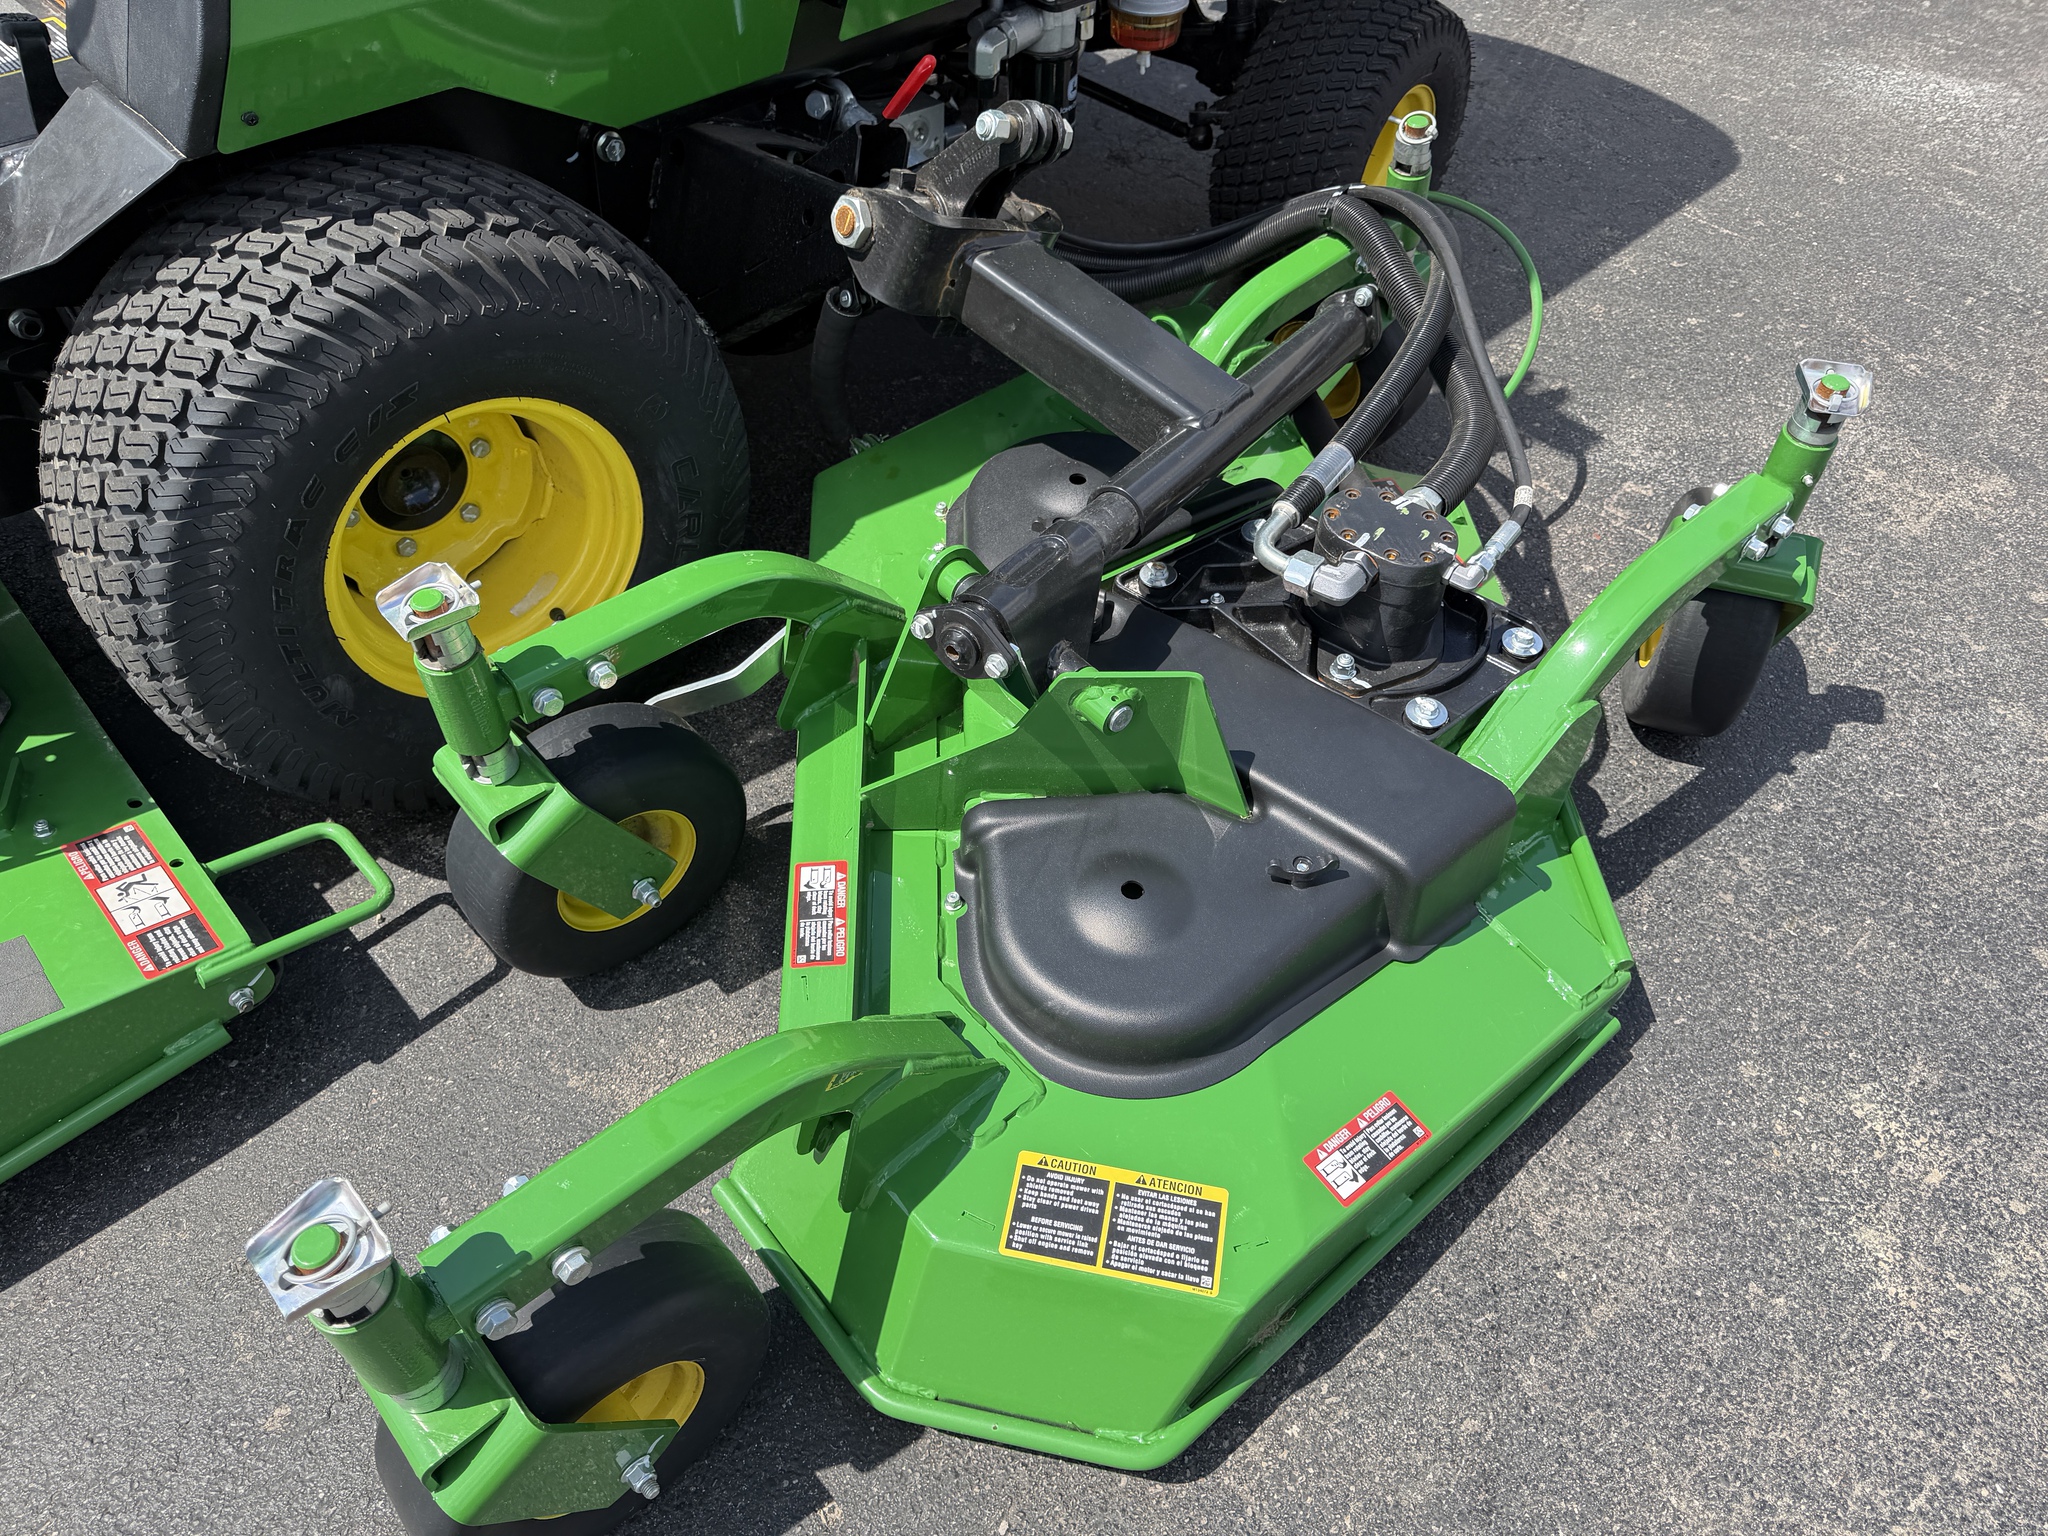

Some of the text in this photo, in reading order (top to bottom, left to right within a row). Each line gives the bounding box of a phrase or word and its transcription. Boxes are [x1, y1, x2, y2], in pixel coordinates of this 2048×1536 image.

[271, 473, 327, 613] TRAC
[276, 625, 360, 730] MULTI
[68, 851, 91, 875] PELIGRO
[837, 881, 846, 908] DANGER
[836, 927, 845, 957] PELIGRO
[127, 940, 151, 966] DANGER
[1363, 1097, 1391, 1121] PELIGRO
[1323, 1128, 1351, 1152] DANGER
[1051, 1159, 1097, 1175] CAUTION
[1046, 1172, 1085, 1184] AVOID INJURY
[1047, 1180, 1069, 1189] operate
[1070, 1184, 1090, 1192] mower
[1149, 1178, 1202, 1196] ATENCION
[1024, 1188, 1039, 1197] Keep
[1040, 1191, 1057, 1200] hands
[1083, 1200, 1099, 1209] away
[1026, 1183, 1074, 1196] shields removed
[1121, 1193, 1129, 1202] No
[1130, 1196, 1144, 1204] usar
[1138, 1189, 1197, 1206] EVITAR LAS LESIONES
[1022, 1194, 1036, 1203] Stay
[1080, 1206, 1099, 1214] driven
[1031, 1216, 1083, 1232] BEFORE SERVICING
[1118, 1213, 1144, 1222] alejados
[1119, 1206, 1147, 1216] Mantener
[1147, 1211, 1157, 1220] las
[1159, 1214, 1178, 1223] manos
[1185, 1218, 1194, 1226] los
[1015, 1229, 1039, 1238] position
[1054, 1237, 1075, 1246] service
[1077, 1240, 1088, 1248] link
[1016, 1221, 1032, 1229] Lower
[1039, 1227, 1056, 1235] secure
[1057, 1230, 1075, 1238] mower
[1081, 1235, 1098, 1243] raised
[1117, 1218, 1151, 1231] Mantenerse
[1152, 1226, 1174, 1235] alejado
[1194, 1234, 1213, 1242] piezas
[1126, 1227, 1160, 1238] movimiento
[1012, 1241, 1023, 1250] key
[1013, 1235, 1027, 1243] Shut
[1038, 1240, 1058, 1249] engine
[1071, 1247, 1094, 1256] remove
[1113, 1240, 1130, 1249] Bajar
[1127, 1235, 1146, 1244] ANTES
[1169, 1243, 1195, 1254] SERVICIO
[1120, 1256, 1144, 1265] servicio
[1139, 1253, 1162, 1262] elevada
[1184, 1261, 1208, 1272] bloqueo
[1110, 1259, 1131, 1269] Apagar
[1138, 1266, 1155, 1274] motor
[1185, 1274, 1199, 1283] llave
